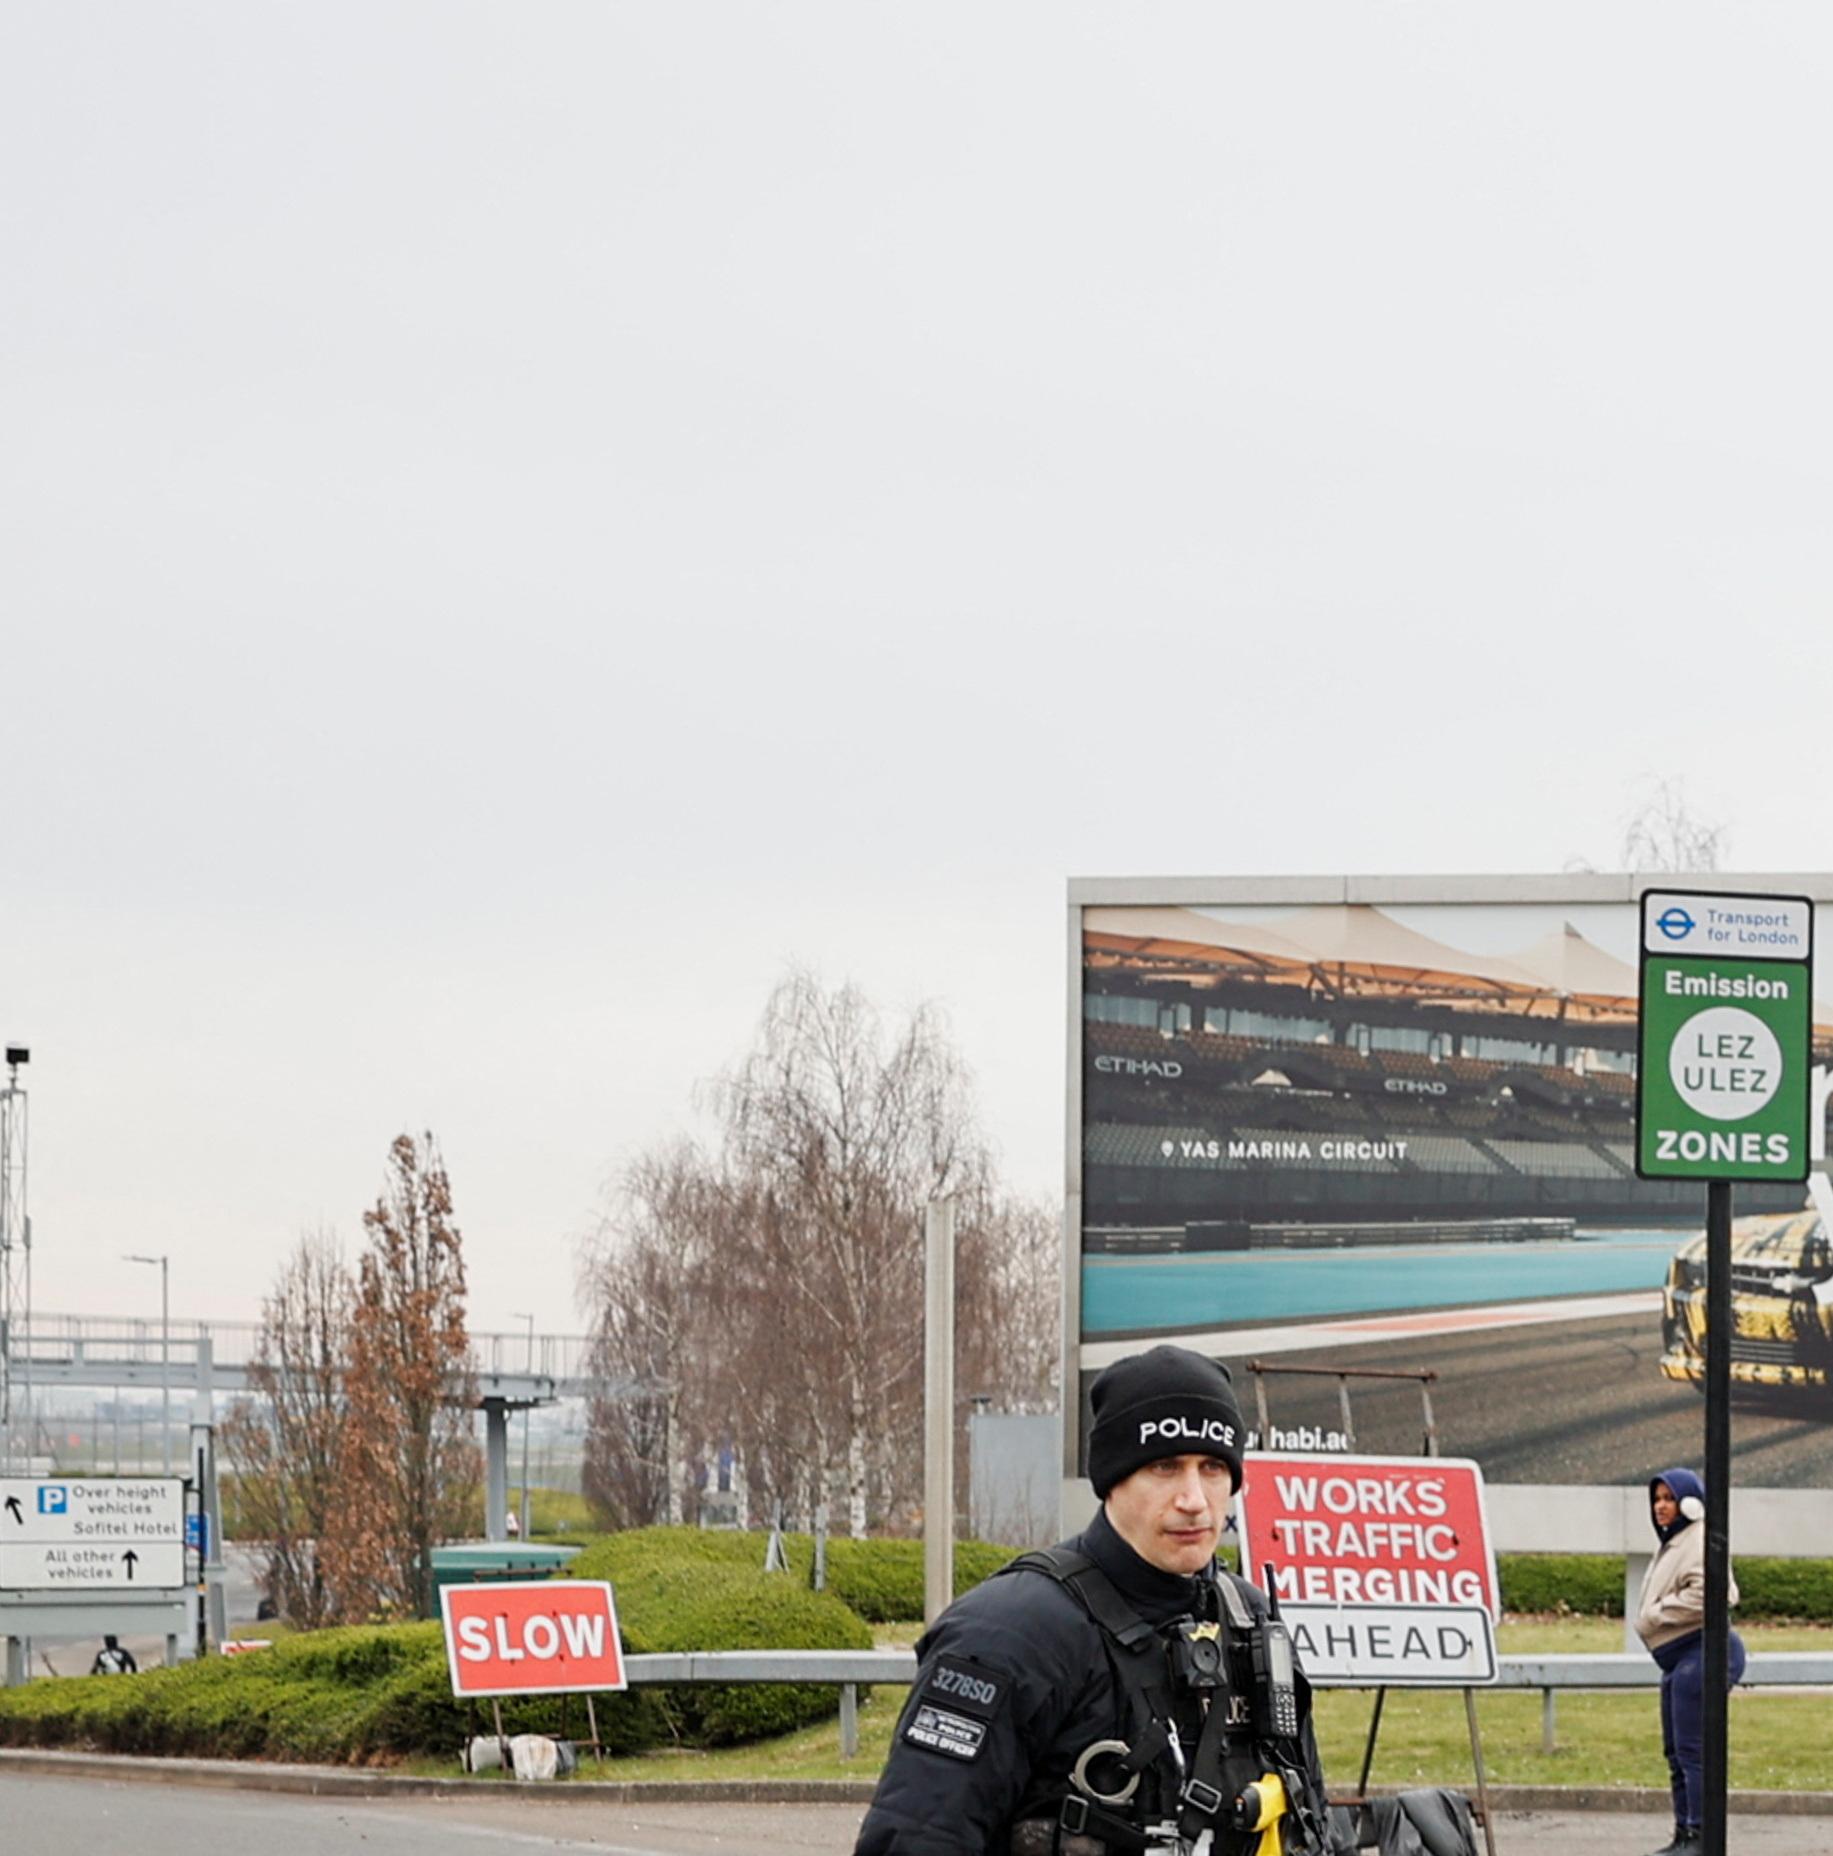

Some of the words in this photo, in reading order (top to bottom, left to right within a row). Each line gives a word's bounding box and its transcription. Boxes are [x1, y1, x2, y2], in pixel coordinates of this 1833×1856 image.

[1708, 909, 1789, 927] Transport
[1708, 928, 1730, 941] for
[1738, 930, 1799, 944] London
[1665, 970, 1789, 999] Emission
[1698, 1034, 1755, 1060] LEZ
[1095, 1055, 1182, 1078] ETIHAD
[1384, 1078, 1447, 1096] ETIHAD
[1684, 1067, 1767, 1093] ULEZ
[1180, 1141, 1219, 1159] YAS
[1228, 1141, 1311, 1160] MARINA
[1319, 1142, 1408, 1160] CIRCUIT
[1656, 1130, 1790, 1163] ZONES
[1140, 1416, 1235, 1448] POLICE
[42, 1489, 64, 1513] P
[73, 1485, 111, 1499] Over
[117, 1486, 166, 1500] height
[88, 1502, 152, 1514] vehicles
[1275, 1474, 1448, 1517] WORKS
[74, 1522, 128, 1535] Sofitel
[134, 1522, 178, 1535] Hotel
[1274, 1519, 1460, 1562] TRAFFIC
[46, 1550, 67, 1562] All
[73, 1550, 115, 1563] other
[48, 1567, 113, 1579] vehicles
[1260, 1565, 1483, 1606] MERGING
[459, 1614, 604, 1662] SLOW
[1292, 1623, 1469, 1660] AHEAD
